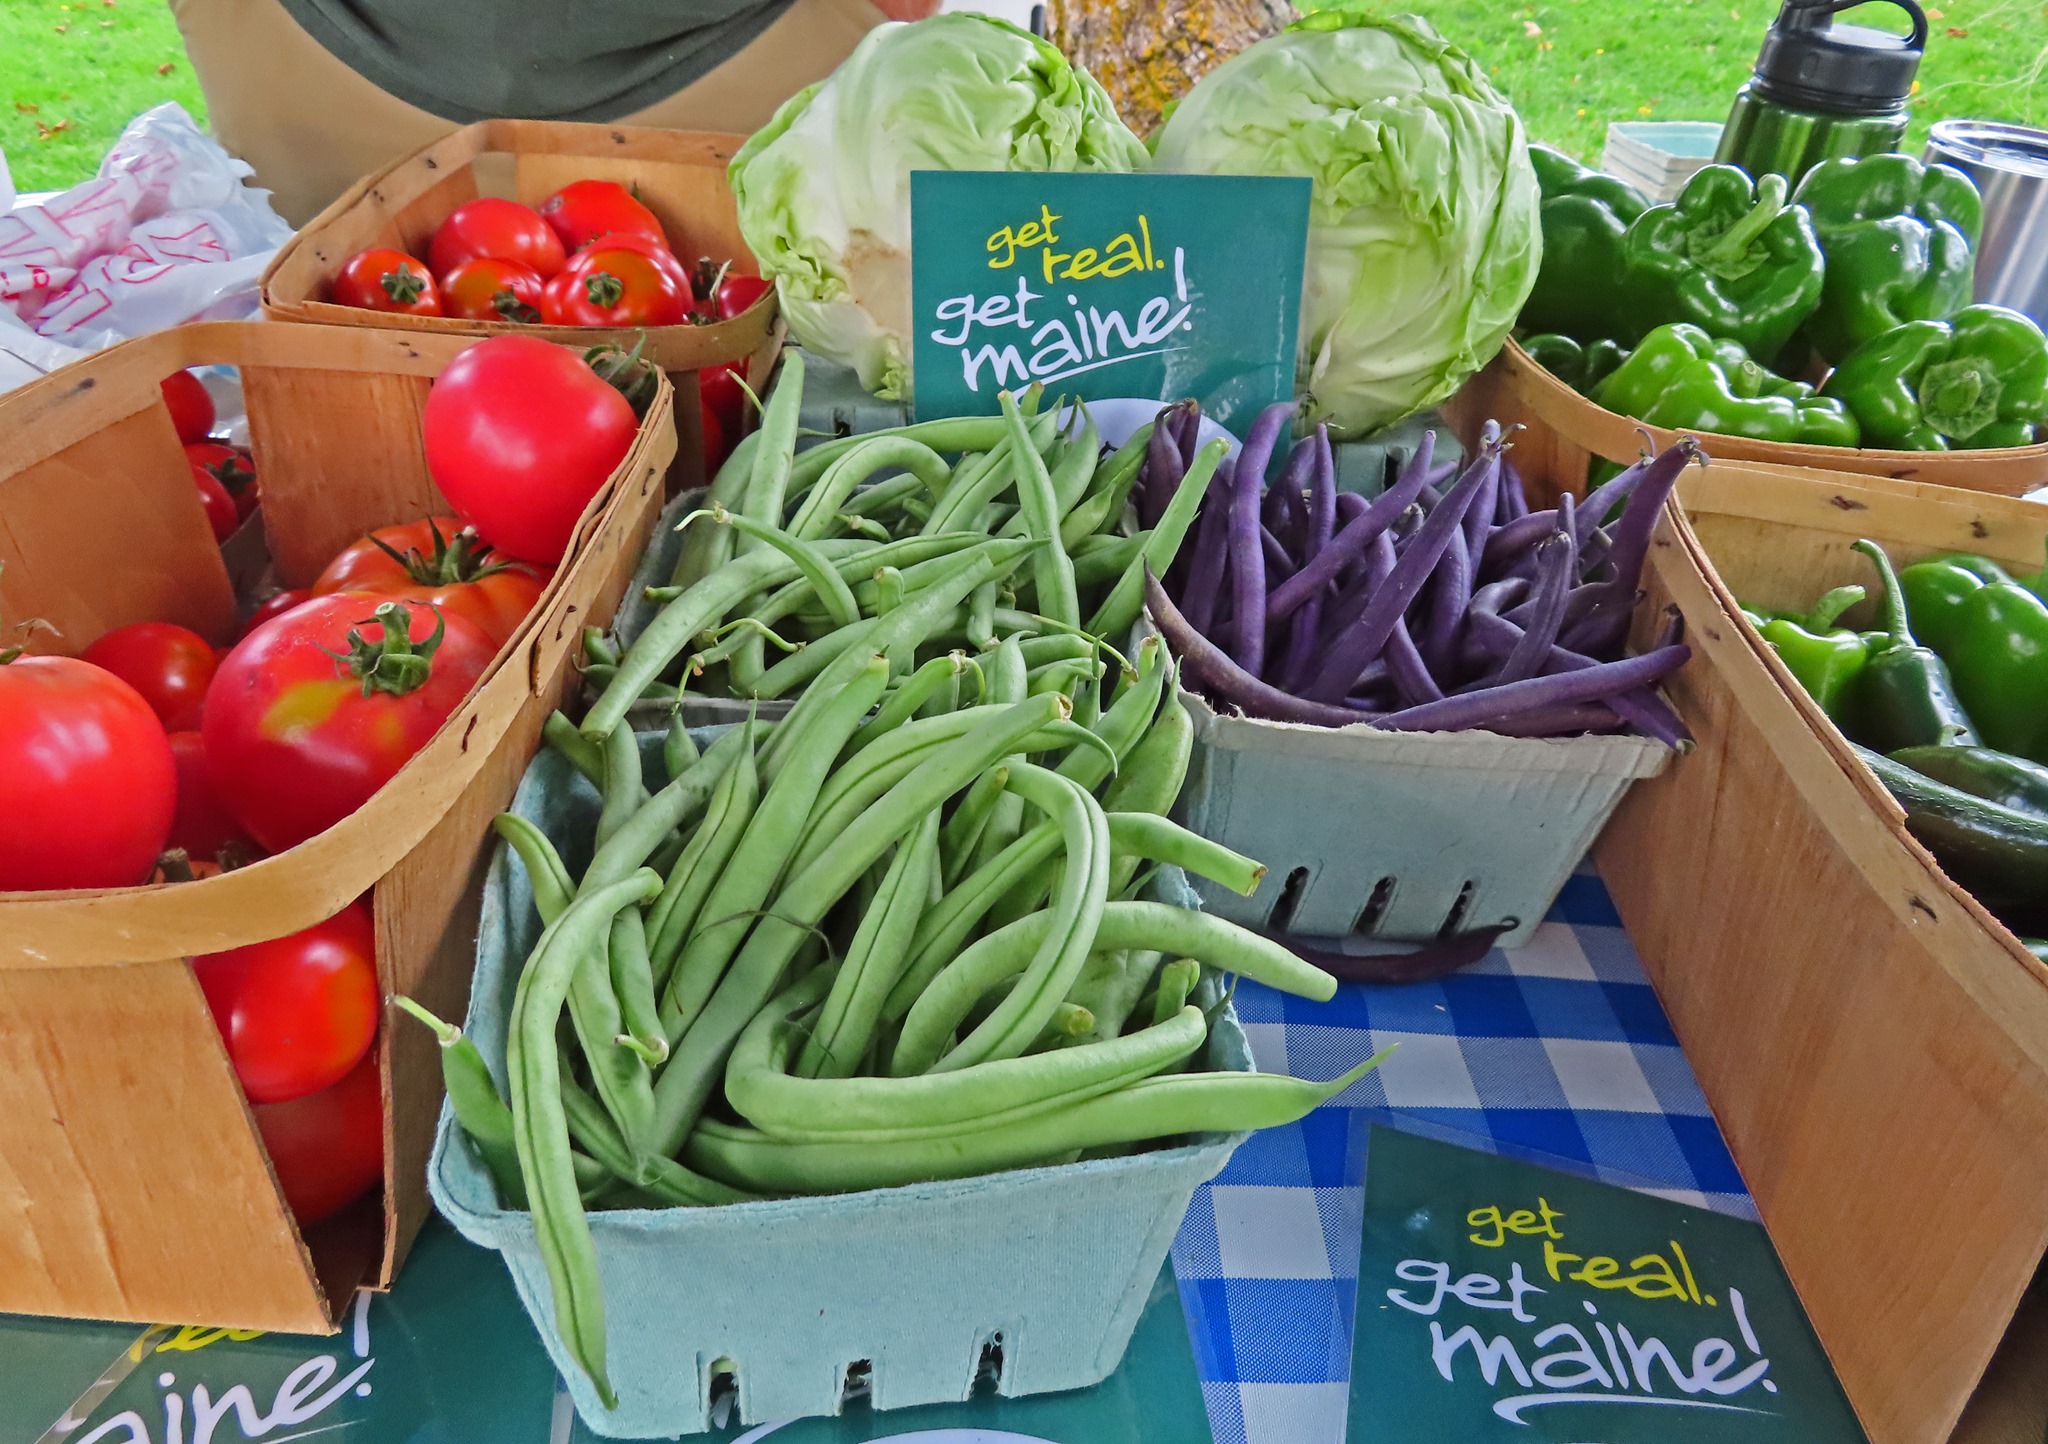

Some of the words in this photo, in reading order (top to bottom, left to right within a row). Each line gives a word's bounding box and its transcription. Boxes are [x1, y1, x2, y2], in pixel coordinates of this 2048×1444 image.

[986, 204, 1063, 269] get
[1042, 214, 1166, 285] real.
[931, 276, 1045, 346] get
[961, 246, 1193, 393] maine!
[1466, 1197, 1565, 1248] get
[1386, 1259, 1548, 1322] get
[1544, 1240, 1718, 1307] real.
[1430, 1286, 1779, 1396] maine!
